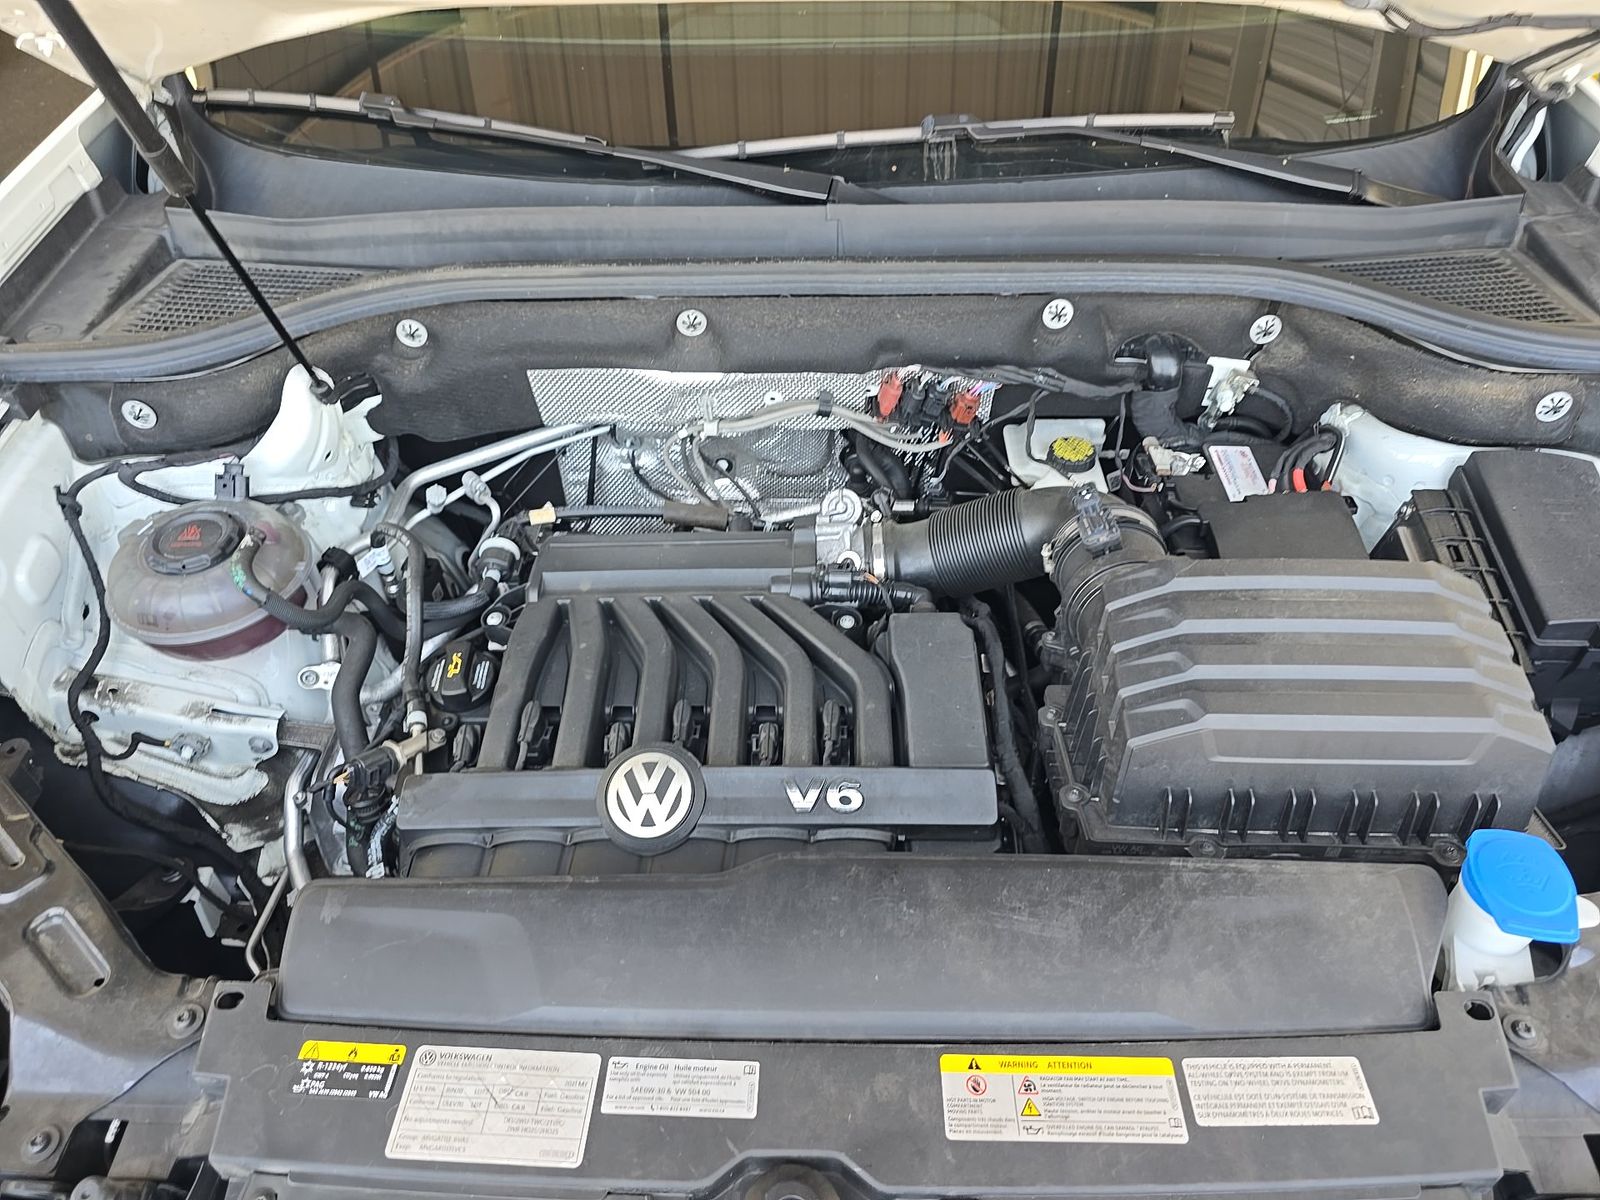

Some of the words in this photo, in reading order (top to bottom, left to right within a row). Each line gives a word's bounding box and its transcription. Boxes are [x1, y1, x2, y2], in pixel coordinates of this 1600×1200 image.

[783, 776, 865, 814] V6
[440, 1052, 493, 1062] VOLKSWAGEN
[999, 1061, 1039, 1069] WARNING
[1047, 1061, 1093, 1069] ATTENTION
[310, 1080, 326, 1089] PAG
